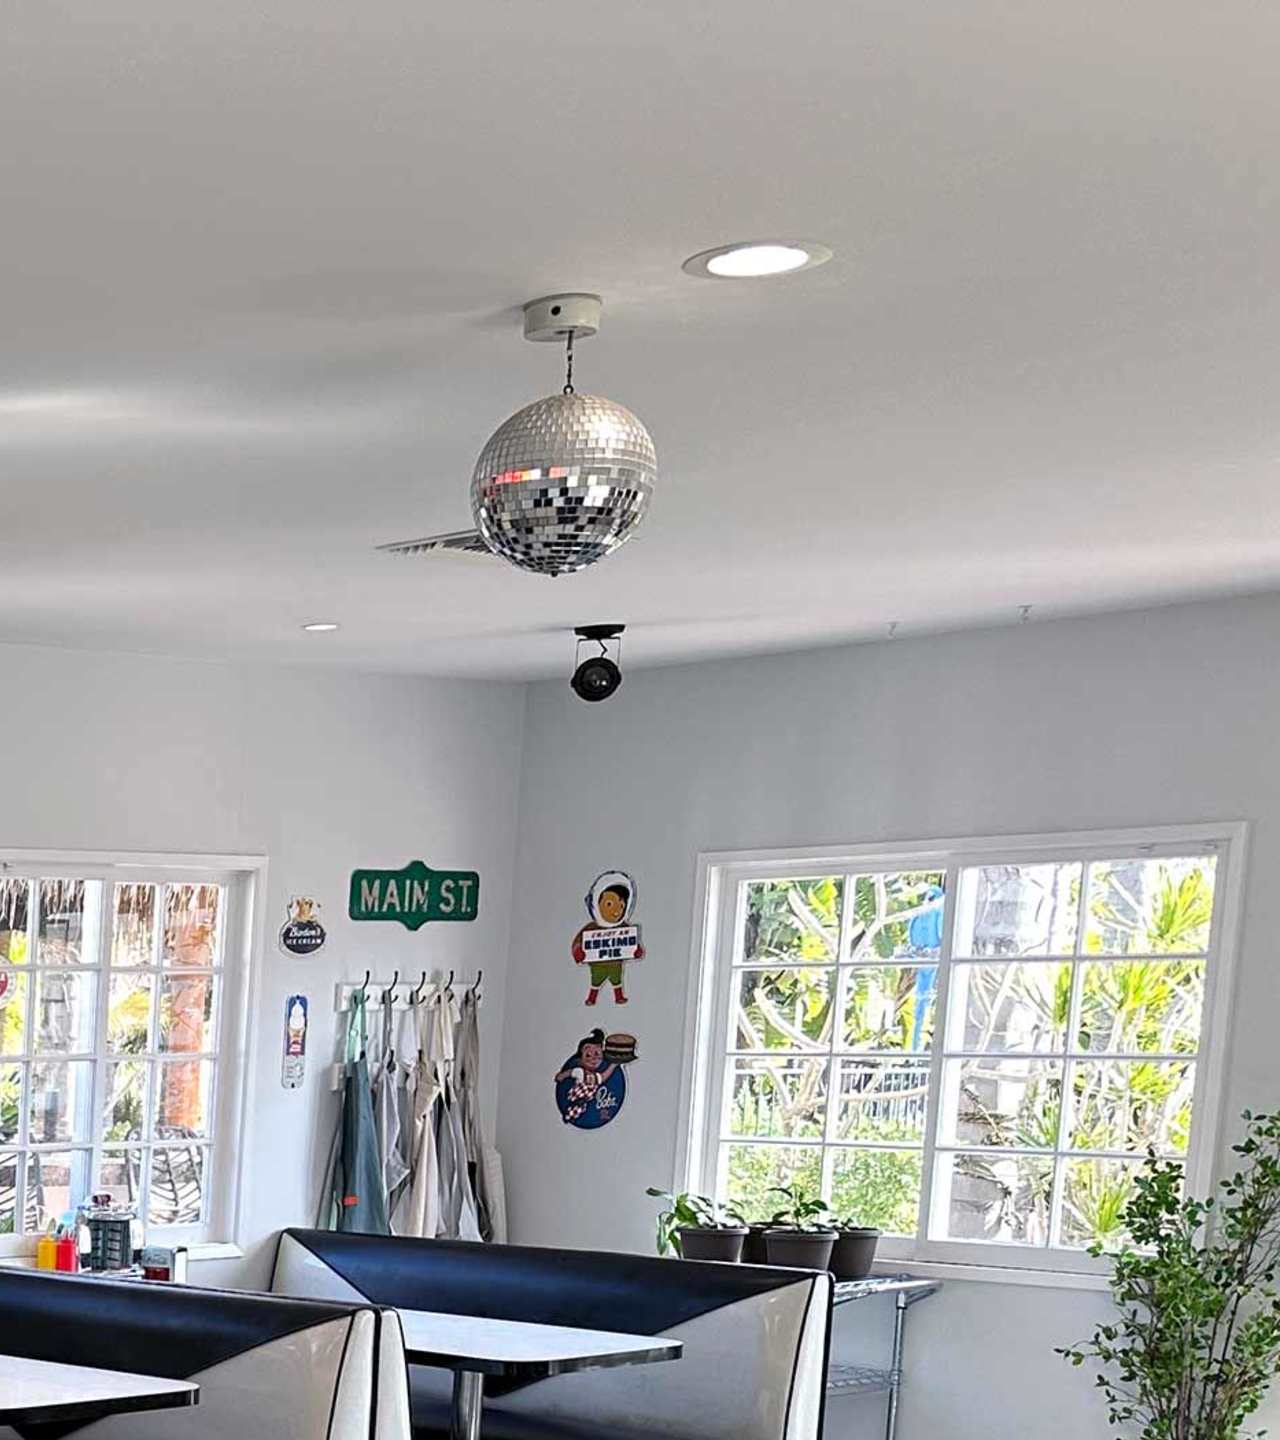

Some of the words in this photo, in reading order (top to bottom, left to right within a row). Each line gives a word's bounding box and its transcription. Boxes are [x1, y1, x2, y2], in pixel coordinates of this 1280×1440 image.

[361, 879, 428, 913] MAIN
[440, 879, 473, 913] ST.
[584, 936, 636, 950] ESKIMO
[598, 948, 621, 958] PIE
